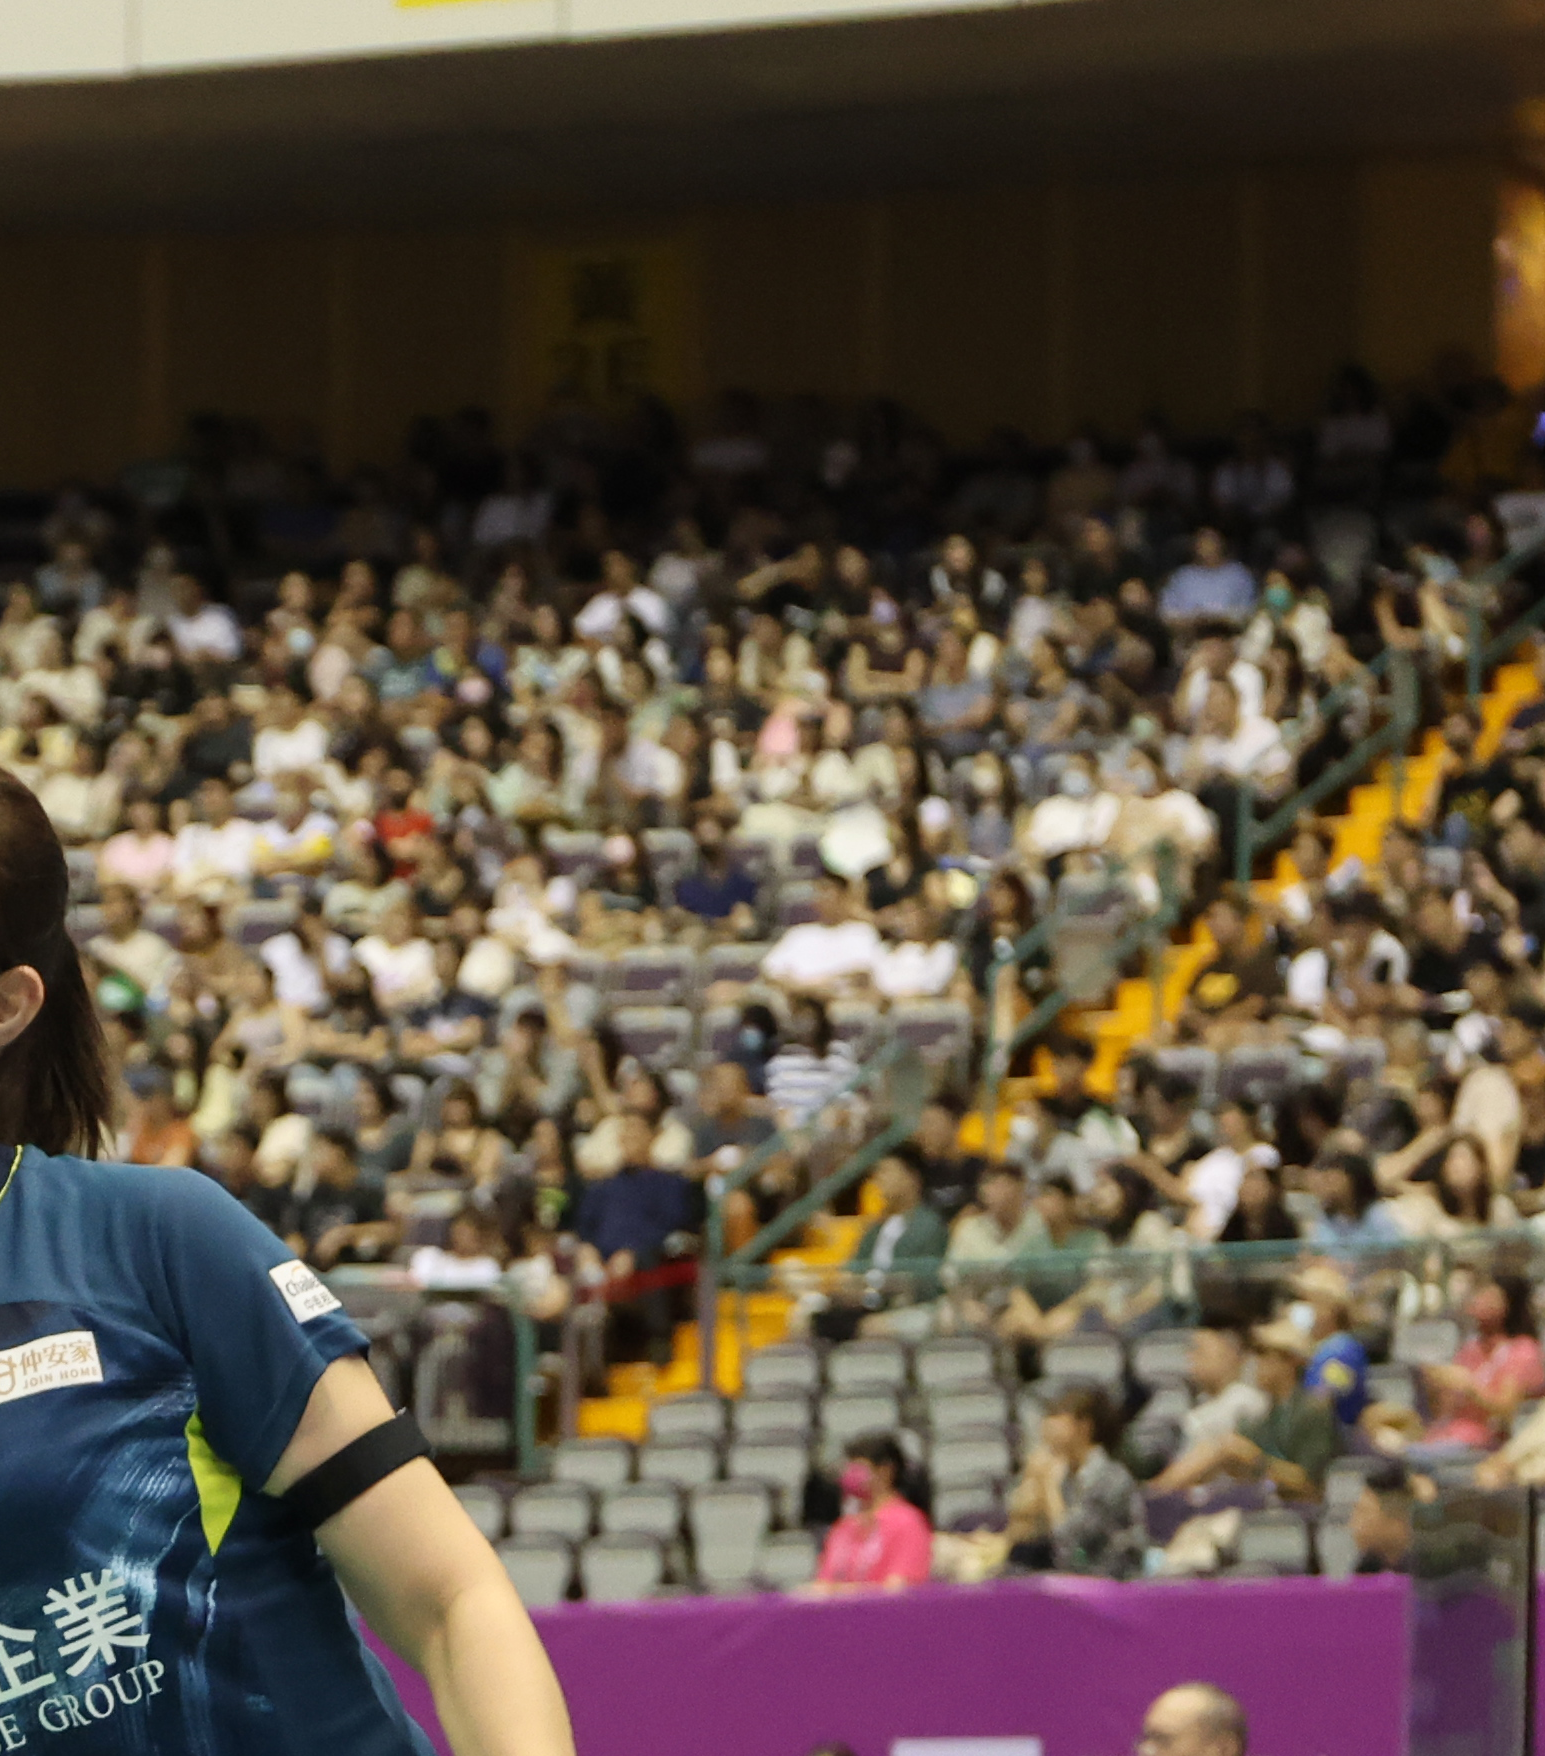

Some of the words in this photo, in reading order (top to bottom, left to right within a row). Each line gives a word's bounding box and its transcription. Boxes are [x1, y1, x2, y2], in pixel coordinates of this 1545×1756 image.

[19, 1339, 95, 1377] 仲安家
[22, 1372, 54, 1390] JOIN
[59, 1366, 98, 1381] HOME
[37, 1658, 166, 1733] GROUP
